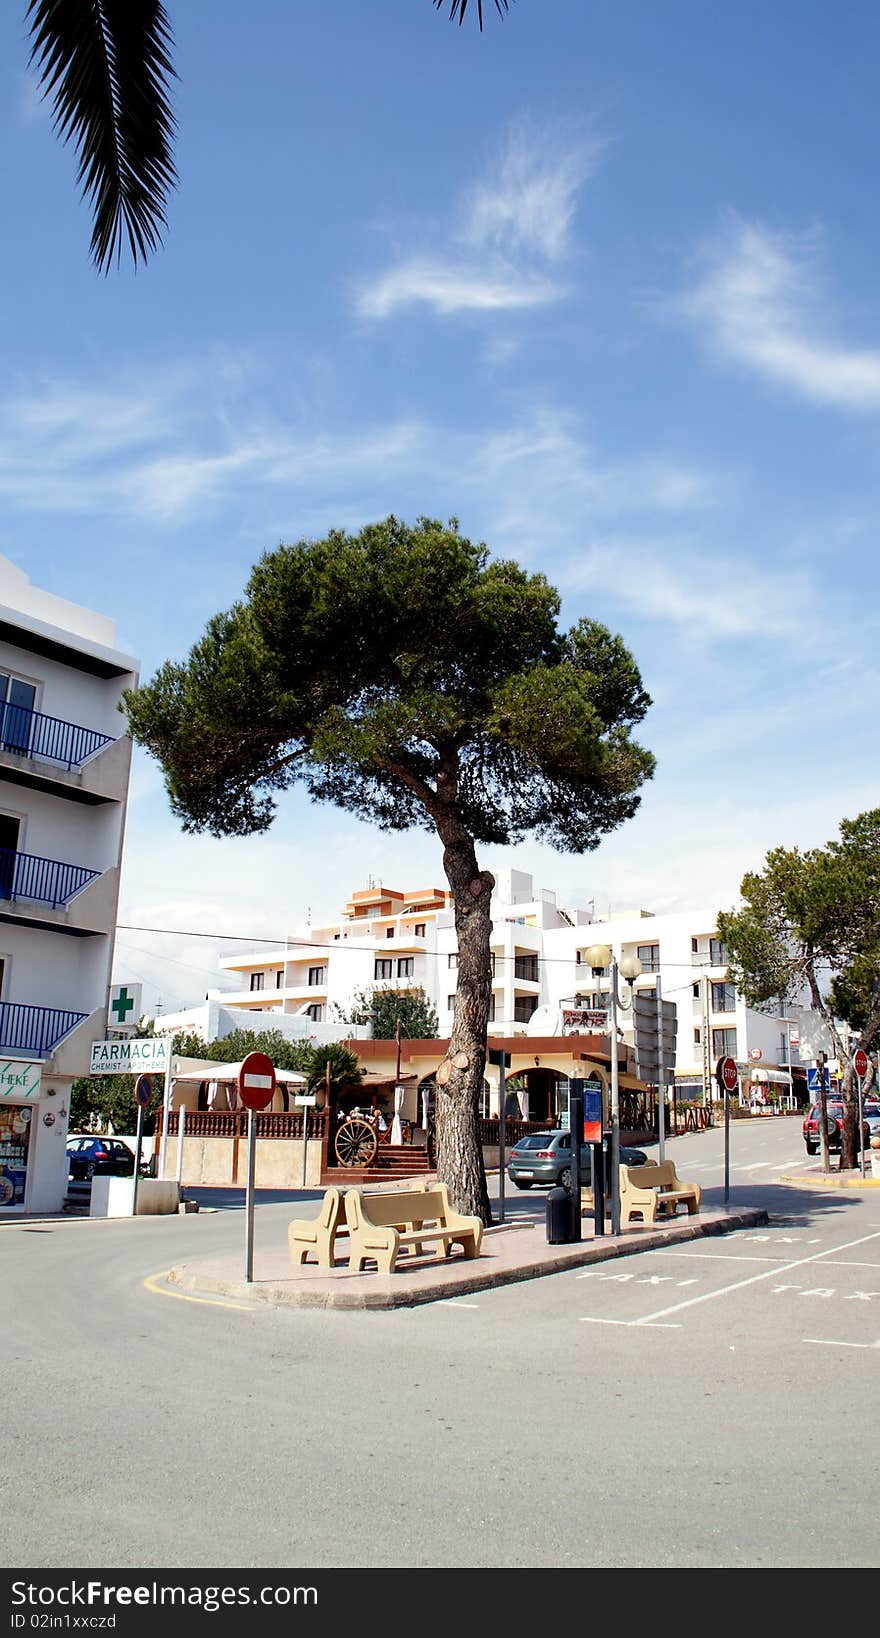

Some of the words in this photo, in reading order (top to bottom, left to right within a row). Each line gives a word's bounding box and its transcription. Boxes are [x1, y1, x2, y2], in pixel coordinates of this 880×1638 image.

[92, 1043, 166, 1060] FARMACIA
[856, 1059, 867, 1067] STOP
[724, 1067, 737, 1078] STOP
[0, 1073, 28, 1087] HEKE
[722, 1234, 822, 1243] TAXI
[575, 1271, 699, 1285] TAXI
